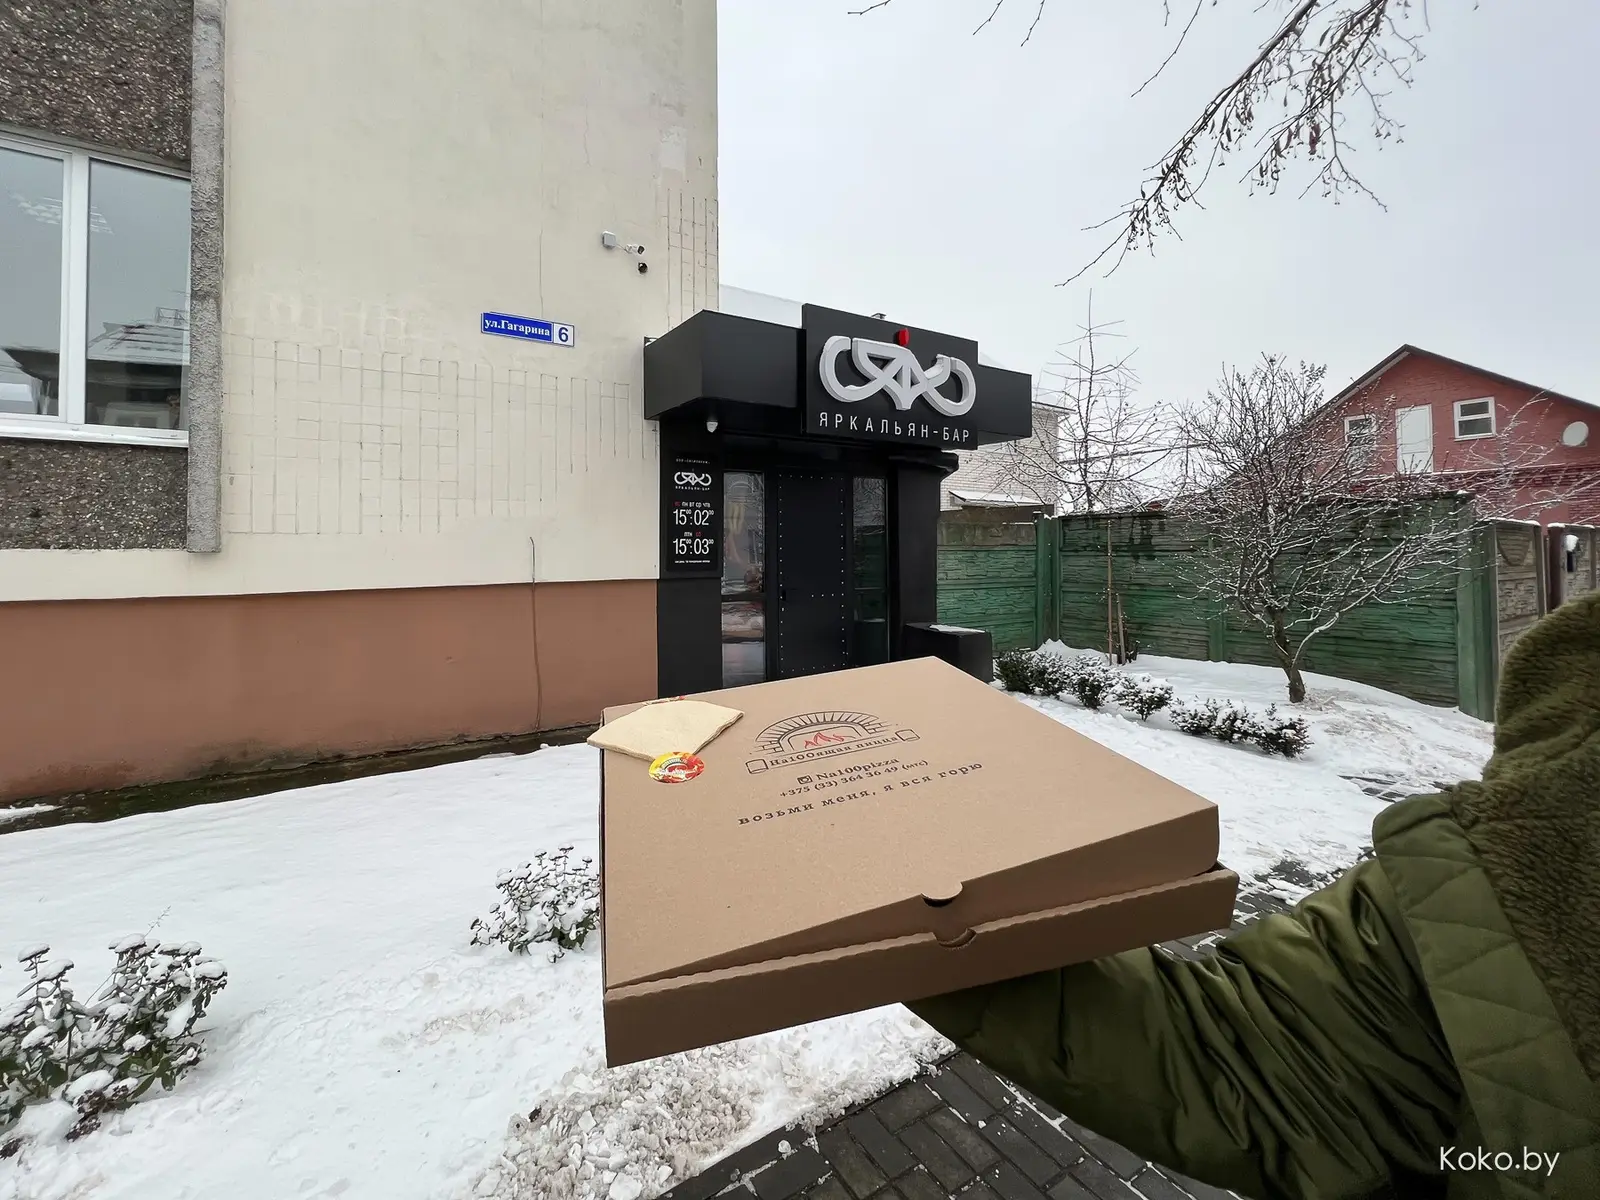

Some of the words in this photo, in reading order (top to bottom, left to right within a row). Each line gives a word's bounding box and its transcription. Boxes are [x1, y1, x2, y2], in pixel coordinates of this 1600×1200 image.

[484, 319, 551, 337] ул.Гагарина
[558, 326, 569, 342] 6
[819, 412, 970, 443] ЯРКАЛЬЯН-БАР
[779, 785, 811, 798] +375
[814, 780, 839, 791] (33)
[840, 774, 865, 784] 364
[865, 770, 882, 778] 36
[884, 766, 899, 774] 49
[816, 758, 900, 781] Na100pizza
[737, 802, 815, 826] возьми
[821, 789, 877, 807] меня,
[883, 783, 894, 792] я
[900, 775, 933, 788] вся
[938, 762, 984, 779] горю
